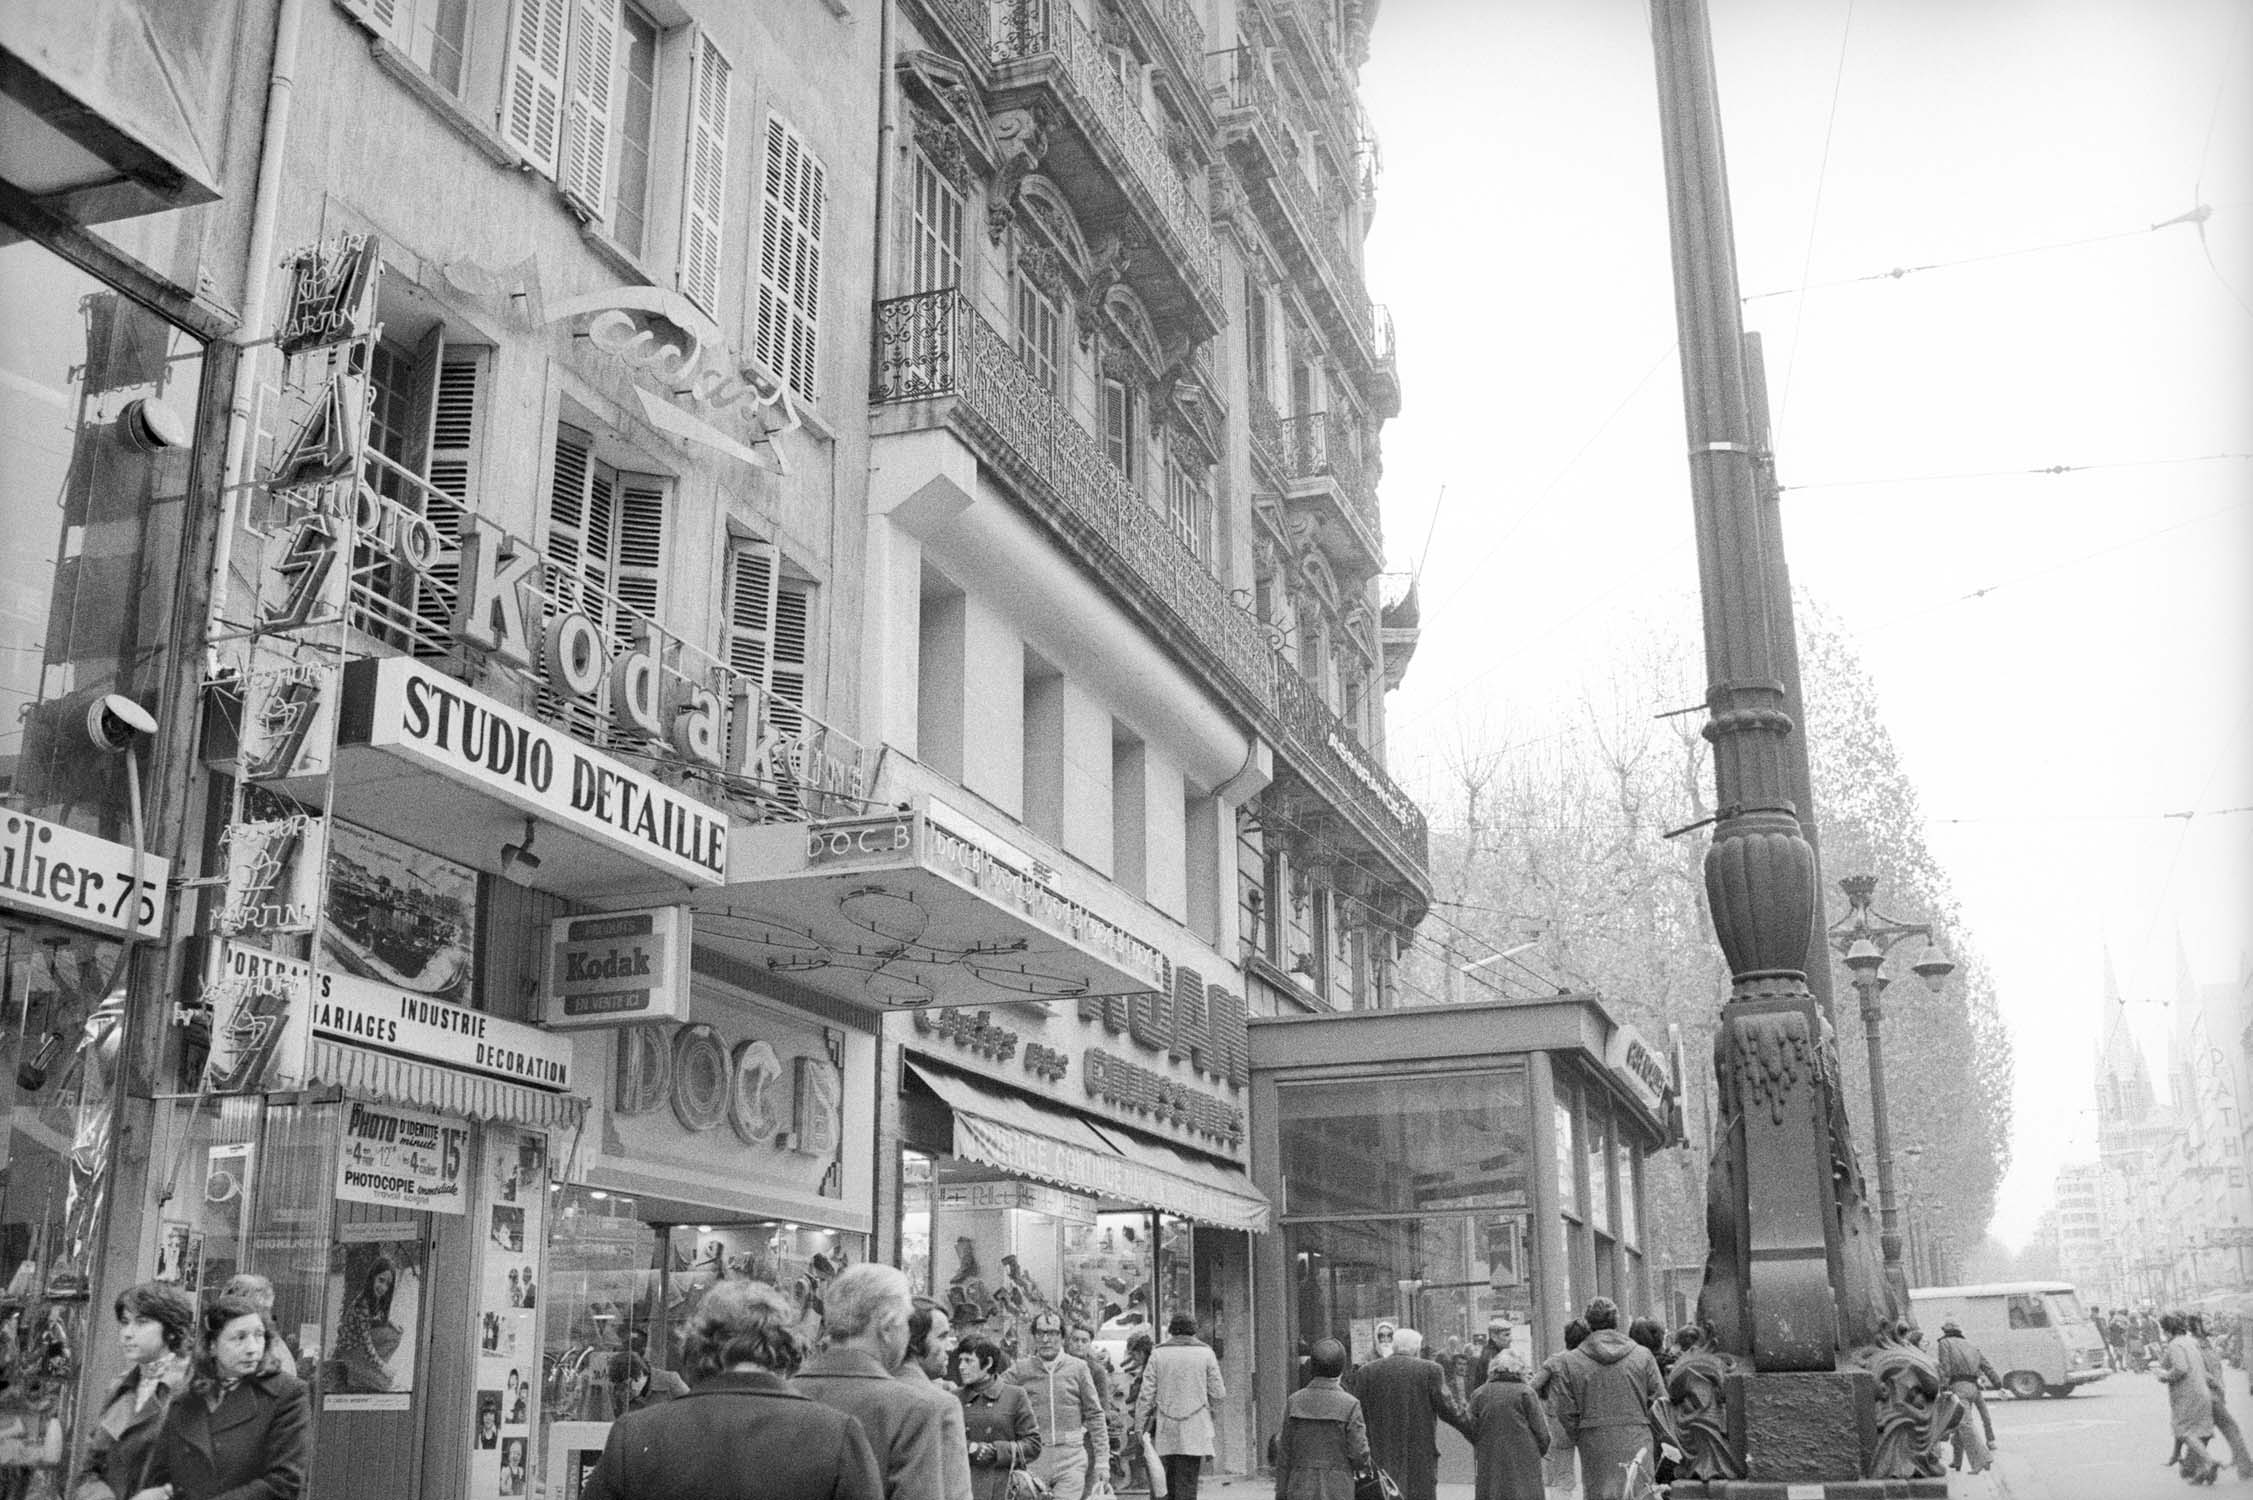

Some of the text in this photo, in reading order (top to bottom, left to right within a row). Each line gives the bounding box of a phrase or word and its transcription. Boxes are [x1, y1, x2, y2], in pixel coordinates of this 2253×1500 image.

[450, 512, 785, 800] Kodak
[403, 675, 726, 875] STUDIO DETAILLE
[566, 946, 651, 982] Kodak
[400, 996, 487, 1039] INDUSTRIE
[476, 1042, 567, 1084] DECORATION
[347, 1109, 399, 1143] PHOTO
[399, 1136, 437, 1151] minute
[353, 1141, 362, 1165] 4
[410, 1151, 419, 1174] 4
[344, 1170, 415, 1194] PHOTOCOPIE
